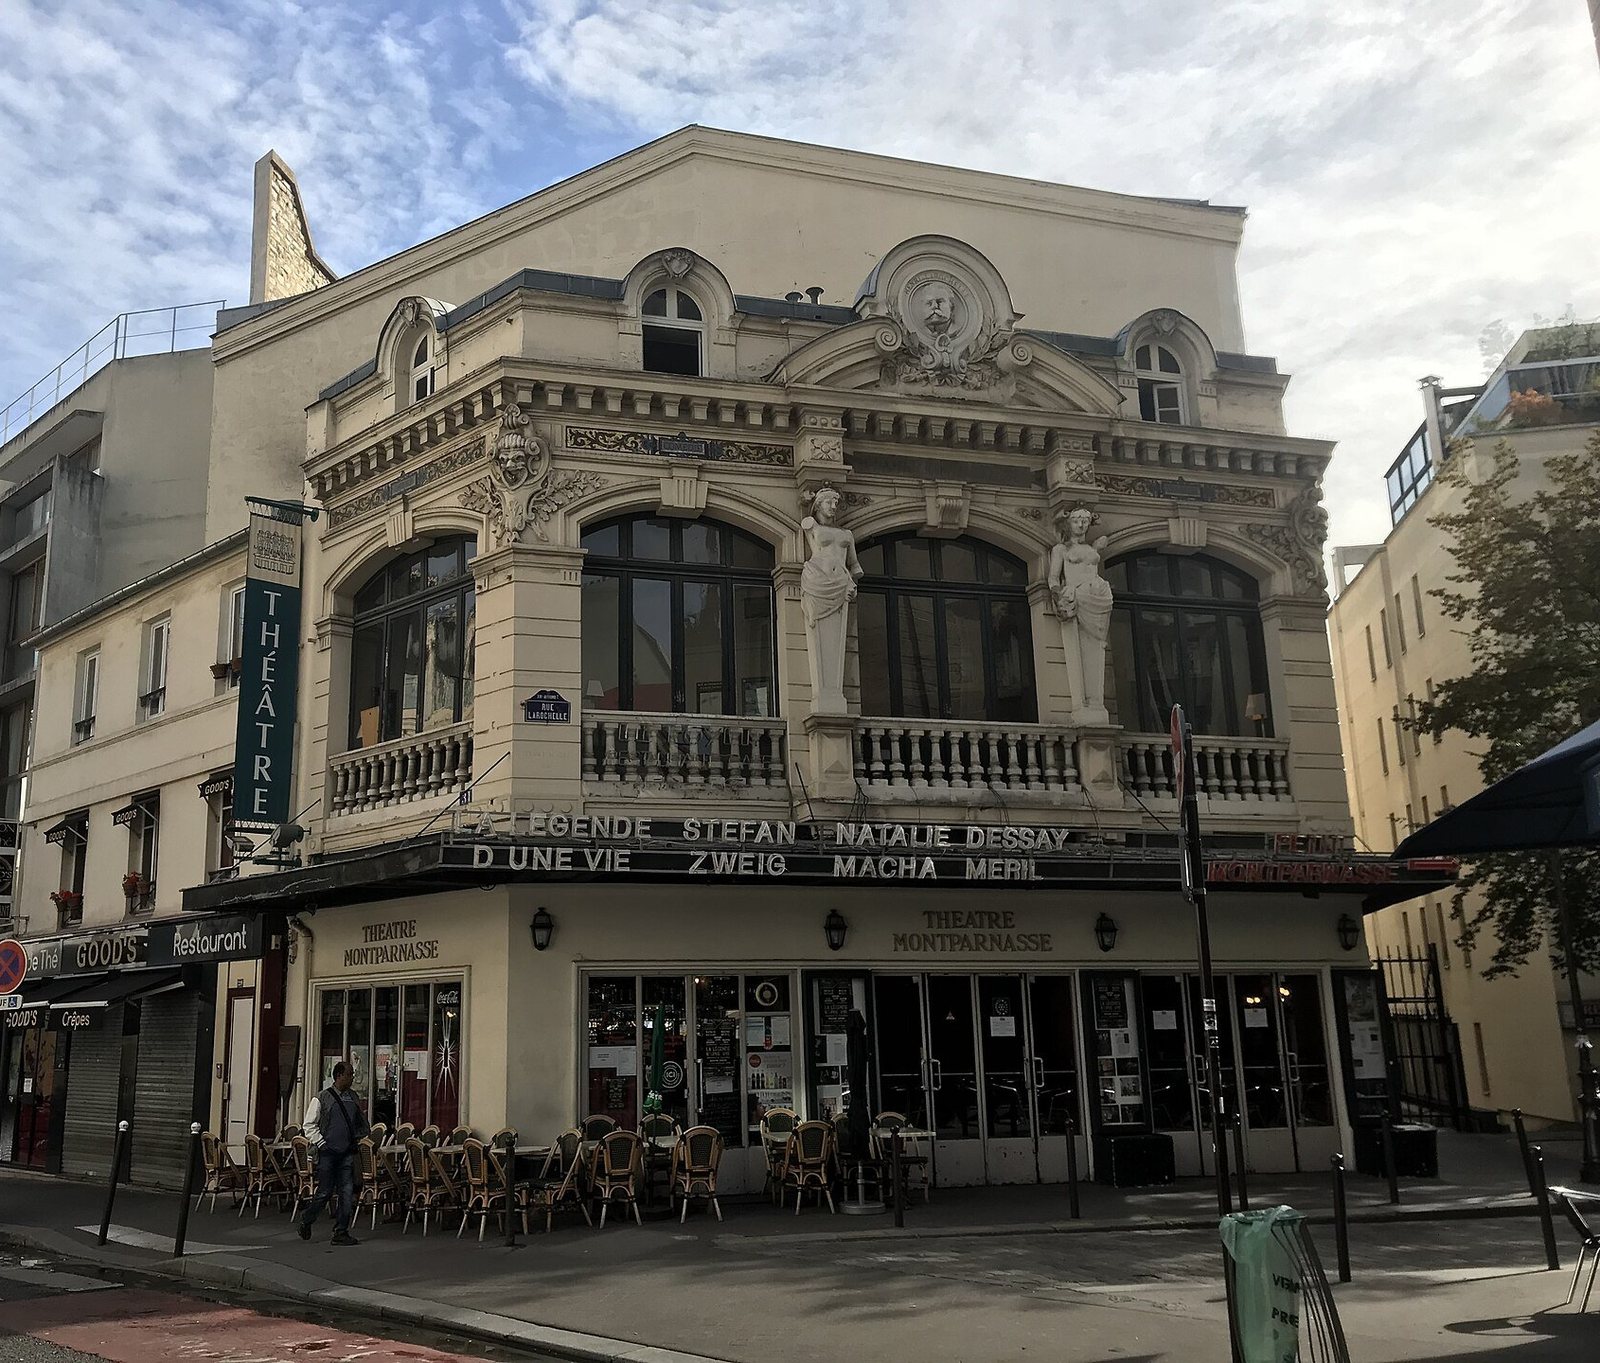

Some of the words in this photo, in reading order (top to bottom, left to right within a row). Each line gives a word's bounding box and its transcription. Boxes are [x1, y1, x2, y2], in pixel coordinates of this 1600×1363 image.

[253, 590, 282, 815] THÉÂTRE
[541, 703, 555, 711] RUE
[528, 712, 567, 720] LAROCHELLE
[205, 779, 230, 796] GOOD'S
[116, 808, 137, 823] GOOD'S
[452, 811, 497, 837] LA
[510, 811, 652, 840] LEGENDE
[49, 830, 67, 842] GOOD'S
[682, 817, 797, 845] STEFAN
[835, 821, 951, 849] NATALIE
[966, 825, 1070, 851] DESSAY
[473, 844, 494, 868] D
[508, 845, 574, 871] UNE
[583, 848, 632, 873] VIE
[688, 850, 788, 877] ZWEIG
[833, 855, 937, 880] MACHA
[965, 857, 1044, 882] MERIL
[1207, 860, 1400, 883] MONTPARNASSE
[362, 919, 417, 943] THEATRE
[923, 911, 1015, 929] THEATRE
[76, 935, 138, 968] GOOD'S
[173, 923, 247, 957] Restaurant
[892, 933, 1054, 953] MONTPARNASSE
[40, 948, 59, 971] Thé
[343, 940, 439, 967] MONTPARNASSE
[61, 1010, 91, 1031] Crêpes
